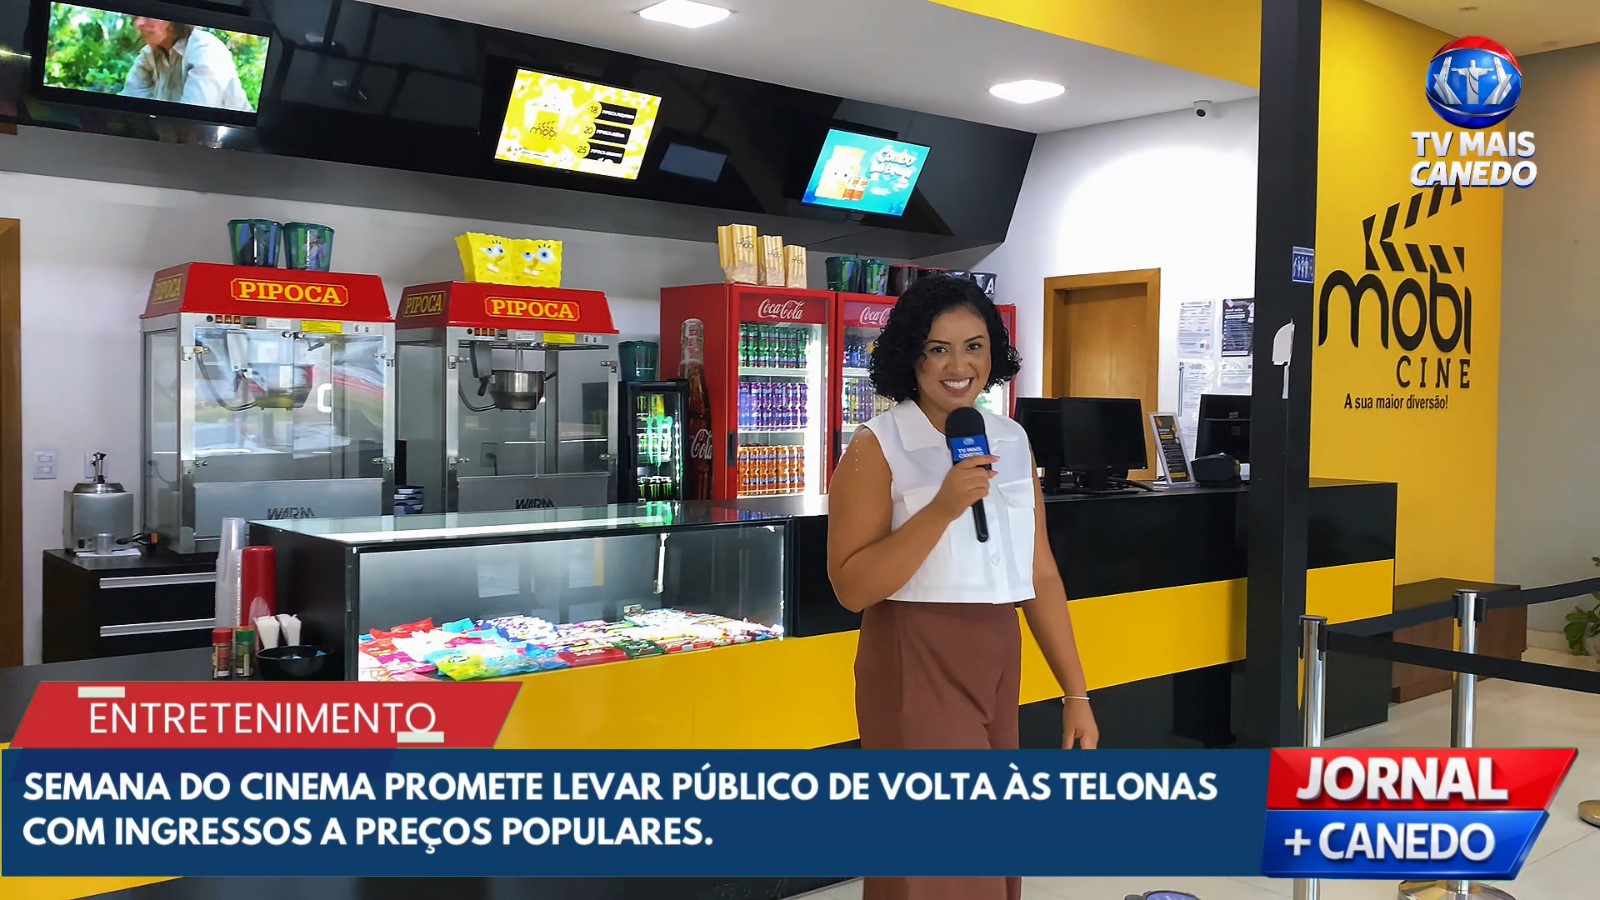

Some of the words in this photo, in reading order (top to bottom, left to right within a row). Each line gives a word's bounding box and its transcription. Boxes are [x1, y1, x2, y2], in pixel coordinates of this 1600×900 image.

[153, 277, 182, 301] PIPOCA
[238, 280, 342, 304] PIPOCA
[404, 293, 443, 315] PIPOCA
[490, 298, 575, 320] PIPOCA
[757, 298, 807, 320] Coca-Cola
[1395, 355, 1471, 389] CINE
[1344, 393, 1353, 409] A
[1355, 396, 1373, 409] sua
[1375, 395, 1403, 409] maior
[1405, 394, 1449, 410] diversão!
[267, 507, 315, 520] WARM
[515, 498, 555, 510] WARM
